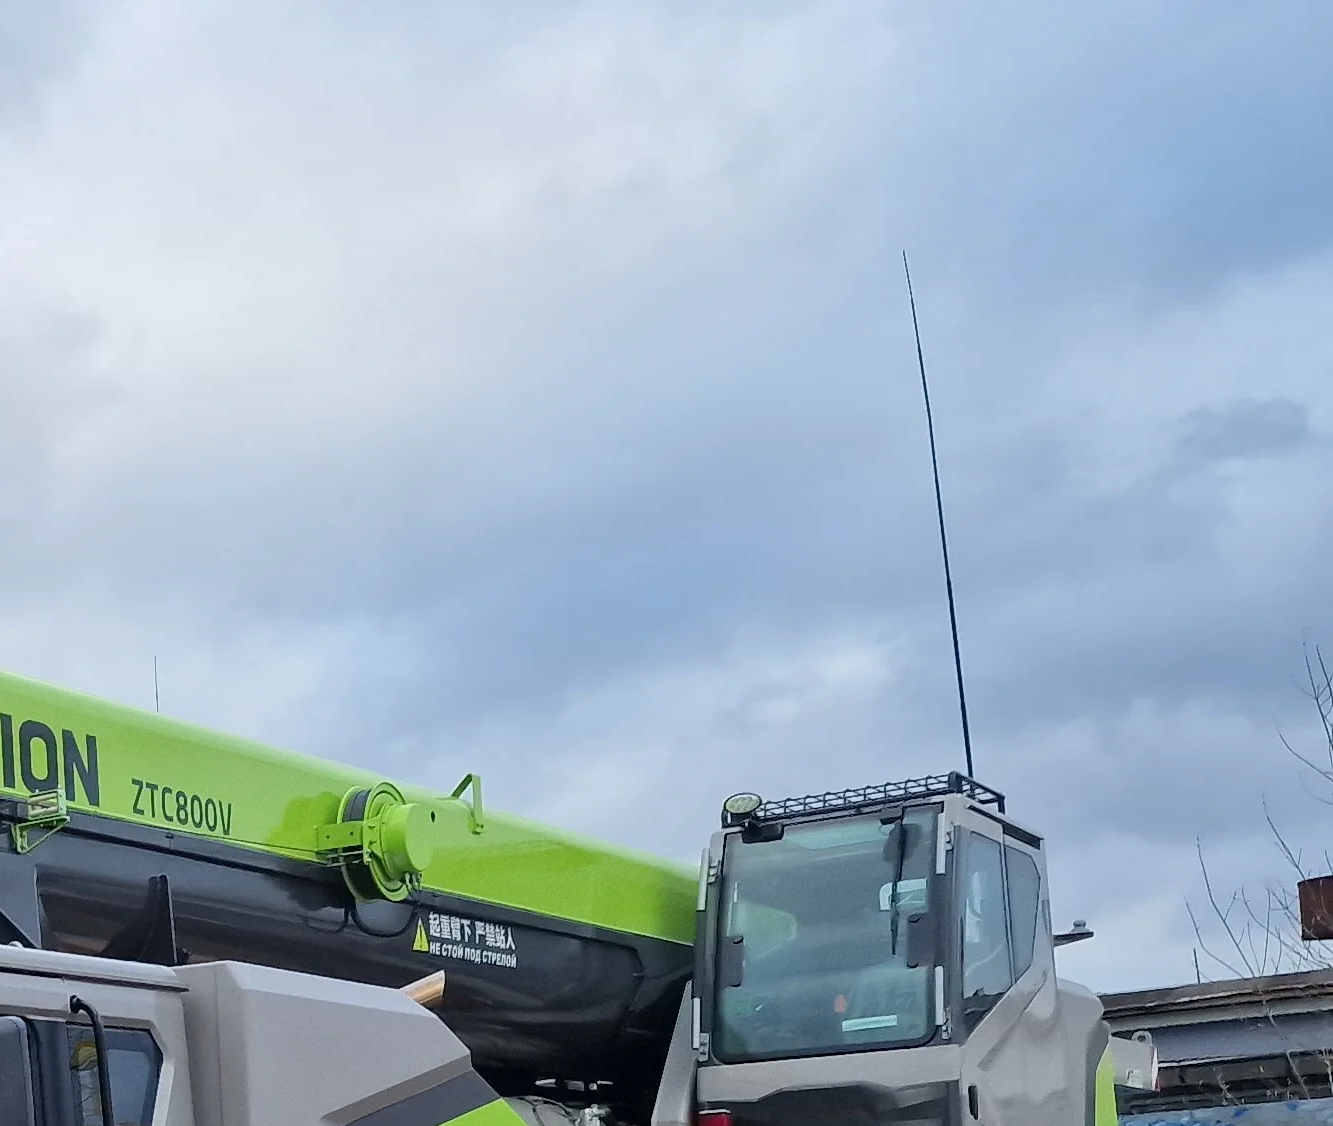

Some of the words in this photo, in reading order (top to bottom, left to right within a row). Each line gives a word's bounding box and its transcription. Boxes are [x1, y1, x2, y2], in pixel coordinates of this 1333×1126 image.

[131, 778, 232, 836] ZTC800V
[429, 941, 441, 955] НЕ
[442, 943, 463, 959] СТОЙ
[464, 947, 482, 964] ПОД
[482, 950, 517, 969] СТРЕЛОЙ
